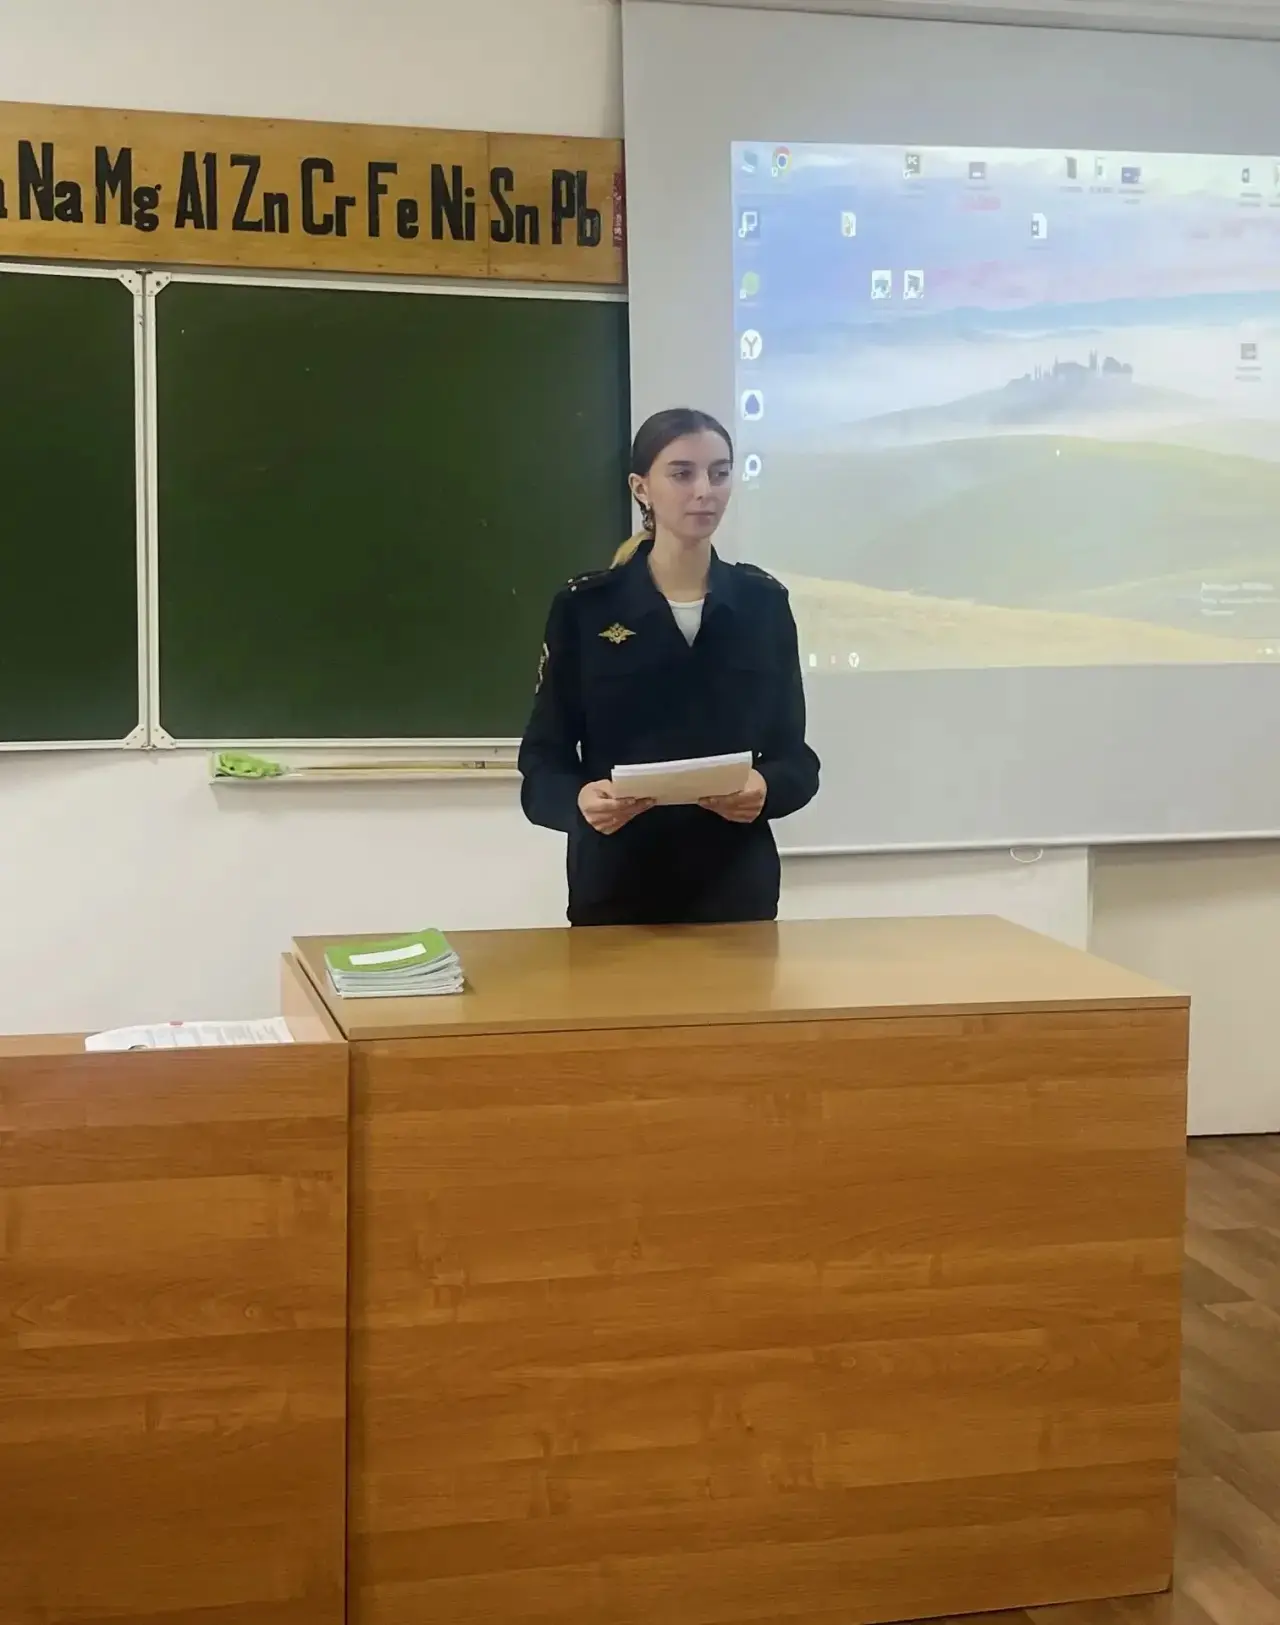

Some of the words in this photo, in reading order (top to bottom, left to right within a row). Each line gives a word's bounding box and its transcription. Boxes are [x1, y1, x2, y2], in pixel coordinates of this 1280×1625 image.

[18, 140, 84, 223] Na
[94, 145, 162, 233] Mg
[229, 153, 290, 234] Zn
[300, 157, 357, 238] Cr
[367, 161, 420, 240] Fe
[430, 163, 476, 242] Ni
[489, 166, 541, 246] Sn
[551, 169, 601, 248] Pb
